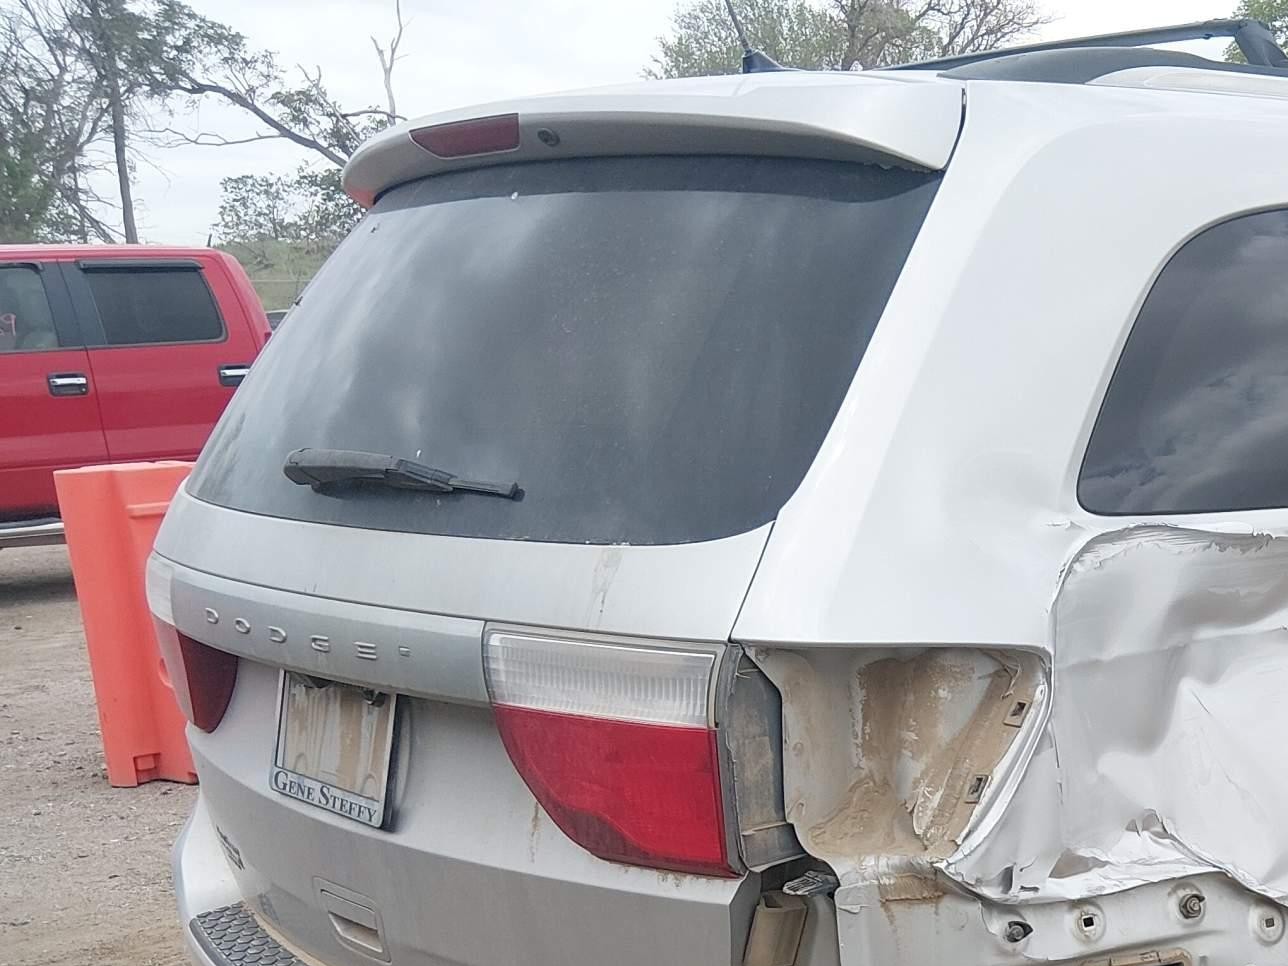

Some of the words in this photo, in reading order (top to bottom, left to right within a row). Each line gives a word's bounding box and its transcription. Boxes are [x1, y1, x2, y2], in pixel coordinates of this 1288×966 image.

[205, 607, 378, 660] DODGE
[273, 770, 315, 801] GENE
[318, 785, 377, 823] STEFFY
